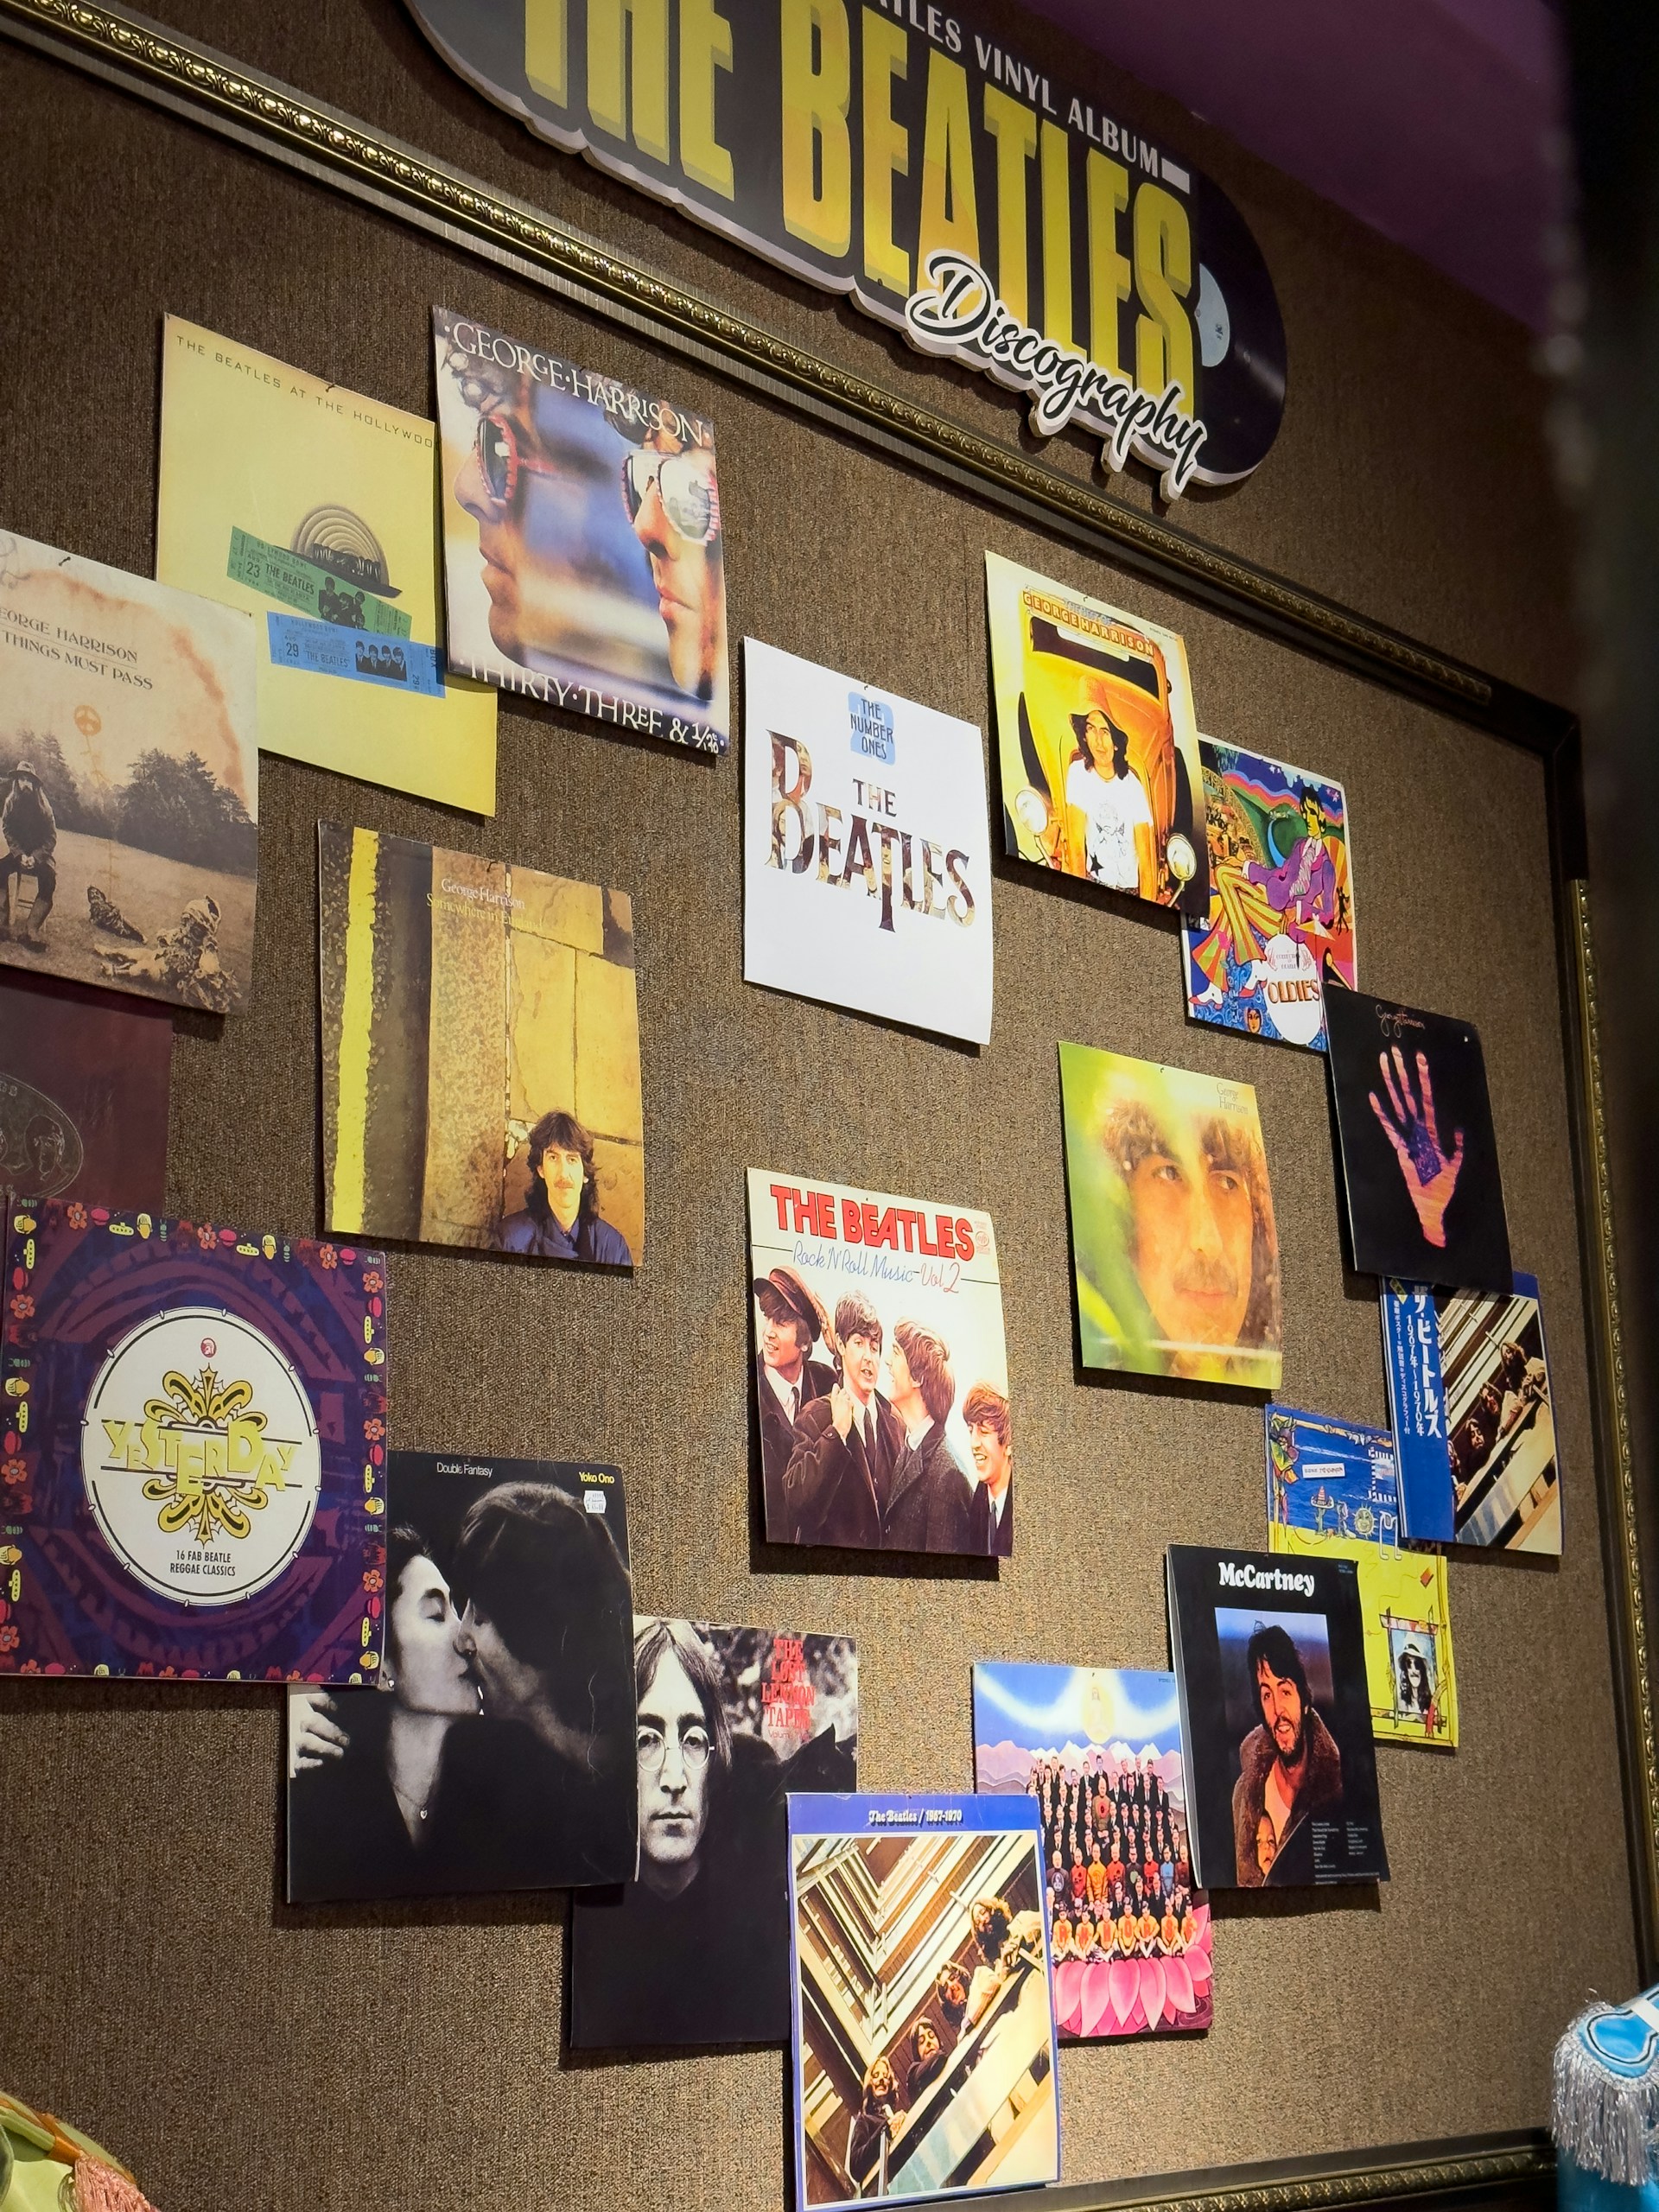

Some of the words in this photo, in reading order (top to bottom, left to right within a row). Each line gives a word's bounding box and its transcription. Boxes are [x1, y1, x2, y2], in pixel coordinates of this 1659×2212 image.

[975, 35, 1057, 115] VINYL
[1068, 97, 1159, 178] ALBUM
[780, 0, 1196, 418] BEATLES
[909, 253, 1208, 478] Discography
[177, 335, 206, 356] THE
[215, 353, 282, 389] BEATLES
[290, 386, 307, 398] AT
[315, 396, 344, 415] THE
[353, 410, 434, 448] HOLLYWOO
[452, 322, 566, 391] GEORGE
[571, 369, 704, 448] HARRISON
[245, 562, 261, 578] 23
[265, 563, 280, 578] THE
[283, 571, 315, 595] BEATLES
[0, 607, 51, 635] EORGE
[57, 626, 138, 664] HARRISON
[1022, 591, 1080, 629] GEORGE
[1080, 617, 1154, 655] HARRISON
[1, 629, 61, 660] THINGS
[65, 652, 108, 676] MUST
[112, 667, 153, 690] PASS
[286, 642, 299, 658] 29
[465, 656, 574, 707] THIRTY
[577, 688, 664, 738] THREE
[670, 717, 689, 745] &
[861, 697, 882, 721] THE
[850, 715, 893, 746] NUMBER
[861, 736, 887, 760] ONES
[852, 778, 897, 817] THE
[765, 729, 976, 933] BEATLES
[426, 893, 485, 918] Somewhere
[441, 878, 480, 903] George
[480, 887, 525, 910] Harrison
[1268, 979, 1320, 1004] OLDIES
[1216, 1082, 1239, 1103] George
[1218, 1096, 1249, 1115] Harrison
[770, 1184, 837, 1240] THE
[841, 1198, 975, 1262] BEATLES
[792, 1240, 826, 1268] Rock
[842, 1248, 869, 1276] Roll
[868, 1254, 915, 1284] Music
[436, 1462, 463, 1475] Double
[463, 1464, 493, 1478] Fantasy
[578, 1471, 598, 1483] Yoko
[598, 1472, 615, 1484] Ono
[169, 1562, 200, 1574] REGGAE
[202, 1565, 236, 1577] CLASSICS
[176, 1549, 186, 1560] 16
[188, 1551, 202, 1561] FAB
[204, 1552, 232, 1563] BEATLE
[1217, 1561, 1315, 1598] McCartney
[773, 1638, 804, 1662] THE
[771, 1659, 806, 1682] LOST
[868, 1809, 886, 1823] The
[886, 1809, 918, 1824] Beatles
[925, 1808, 963, 1823] 1967-1970
